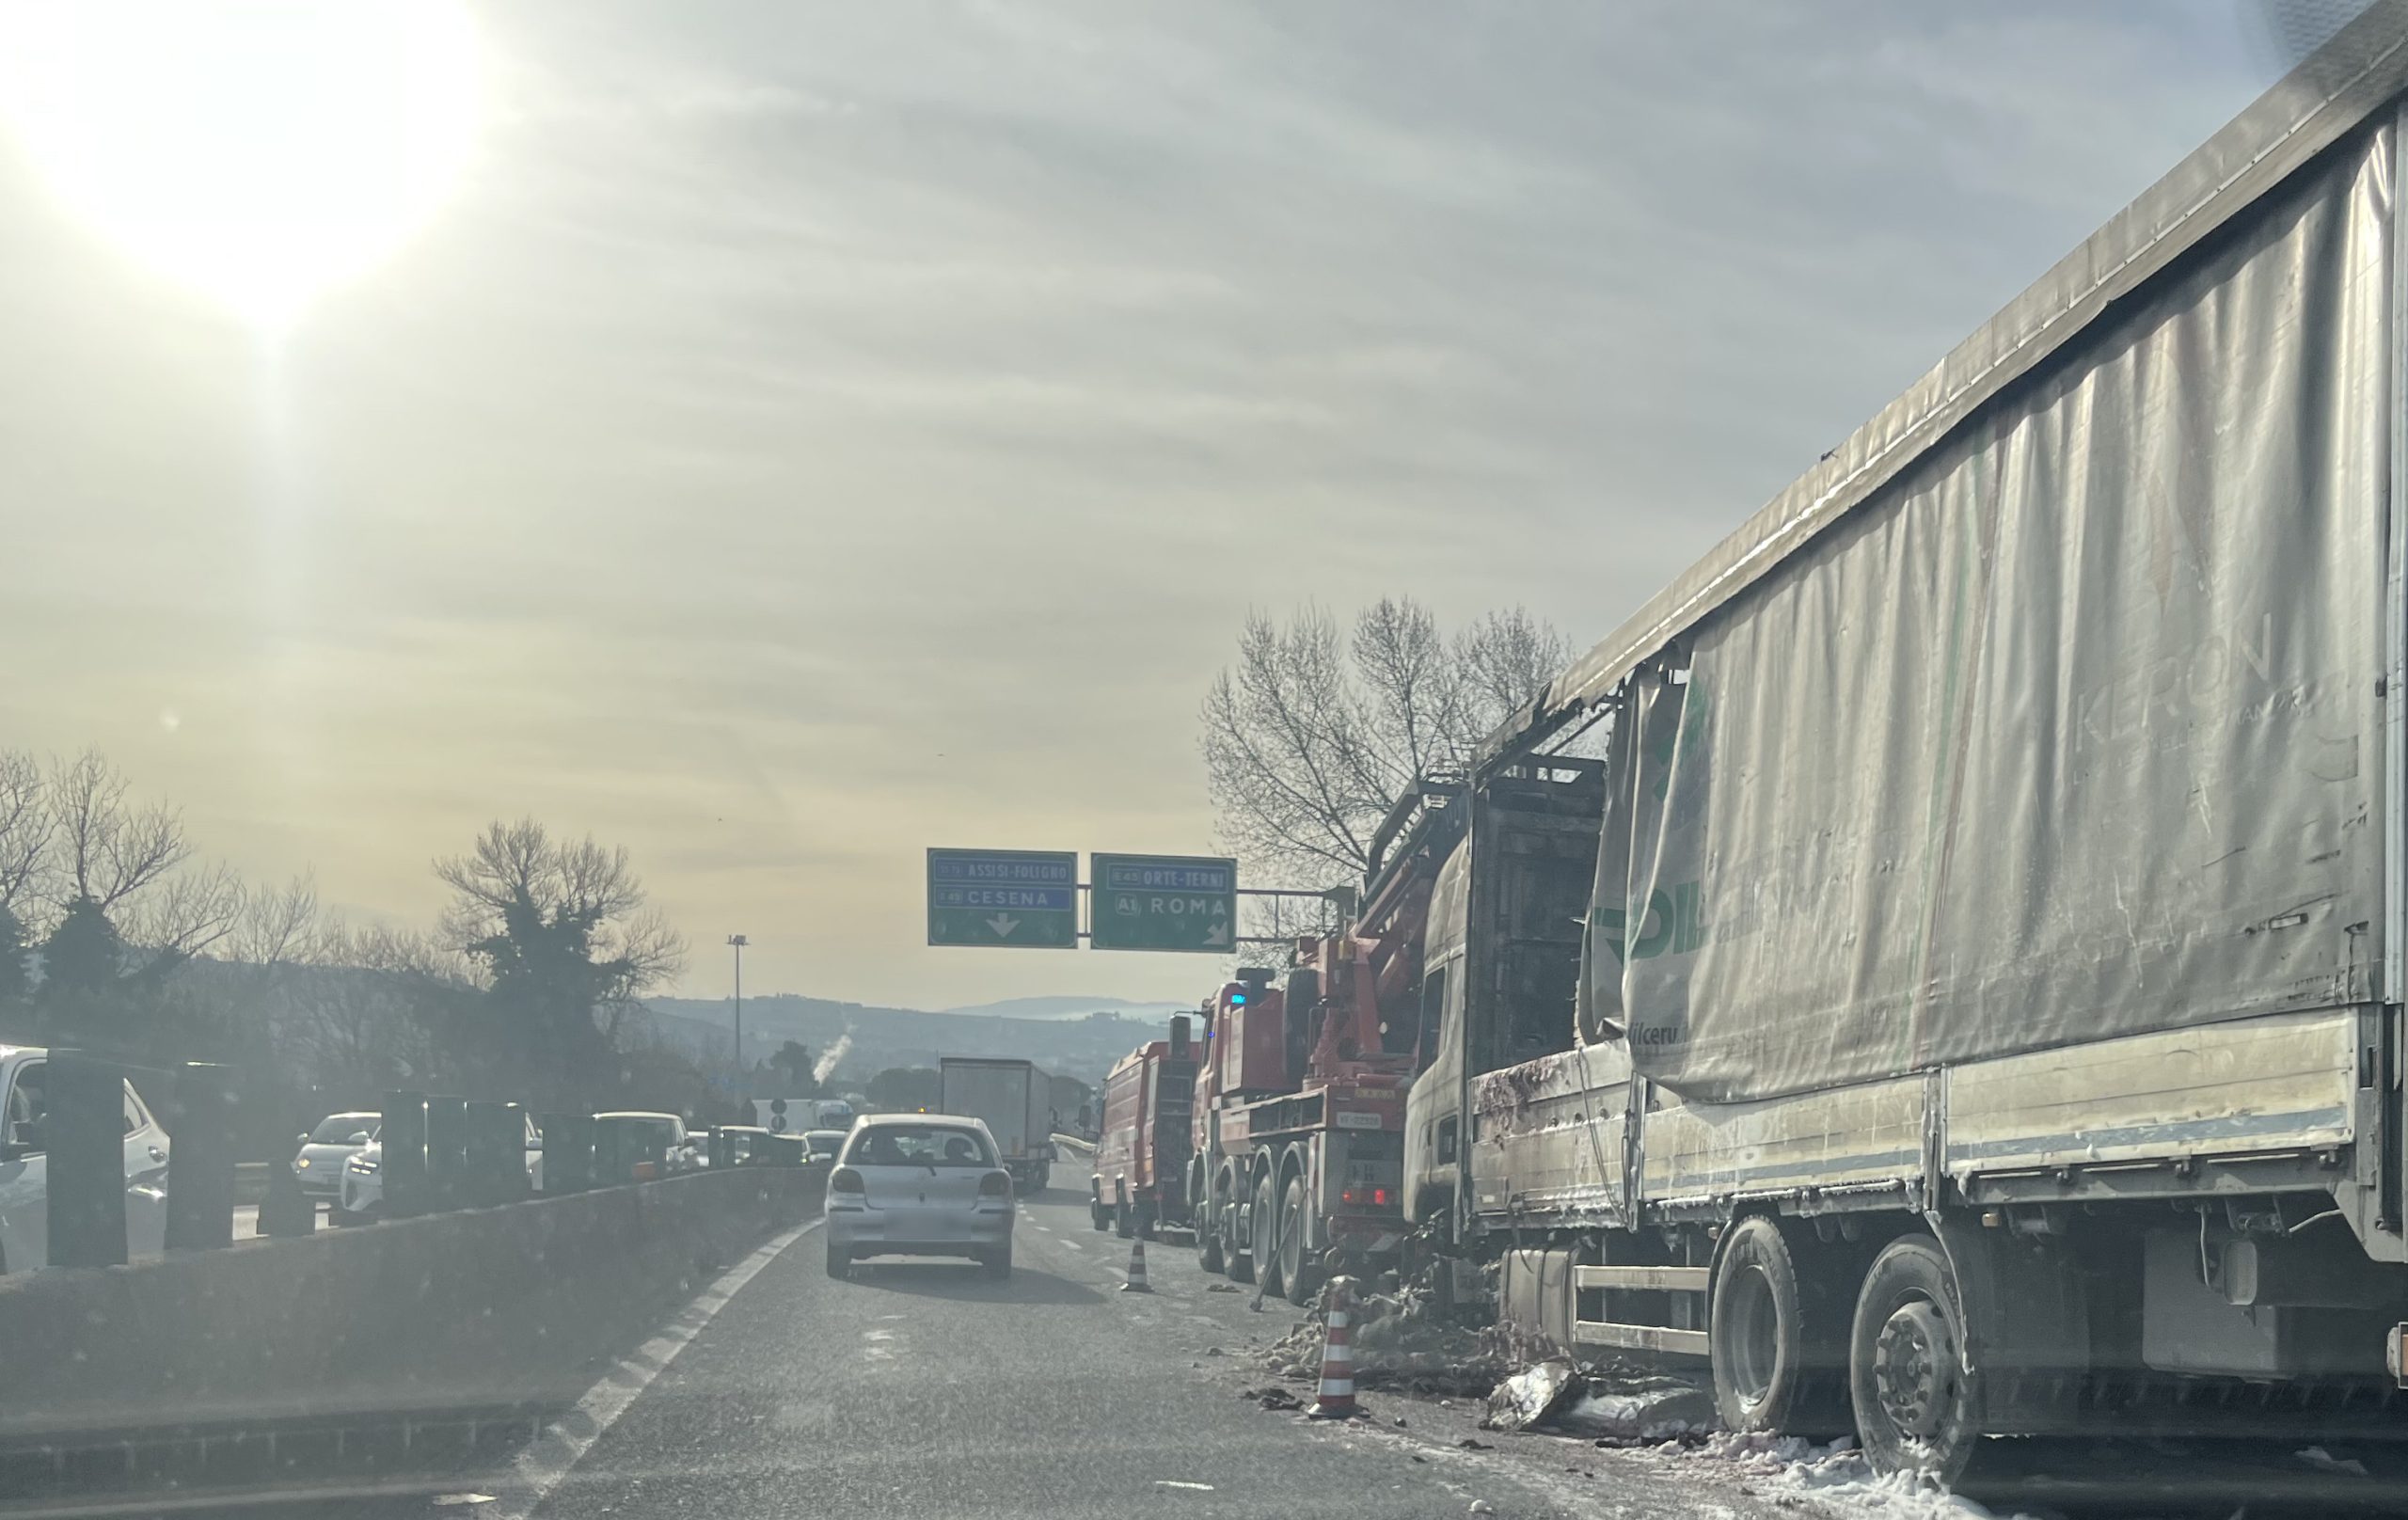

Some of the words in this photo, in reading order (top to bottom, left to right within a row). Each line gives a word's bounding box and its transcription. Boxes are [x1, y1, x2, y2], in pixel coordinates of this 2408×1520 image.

[968, 863, 1067, 879] ASSISI-FOLIGNO
[1144, 871, 1224, 887] ORTE-TERNI
[968, 891, 1048, 906] CESENA
[1150, 897, 1226, 915] ROMA
